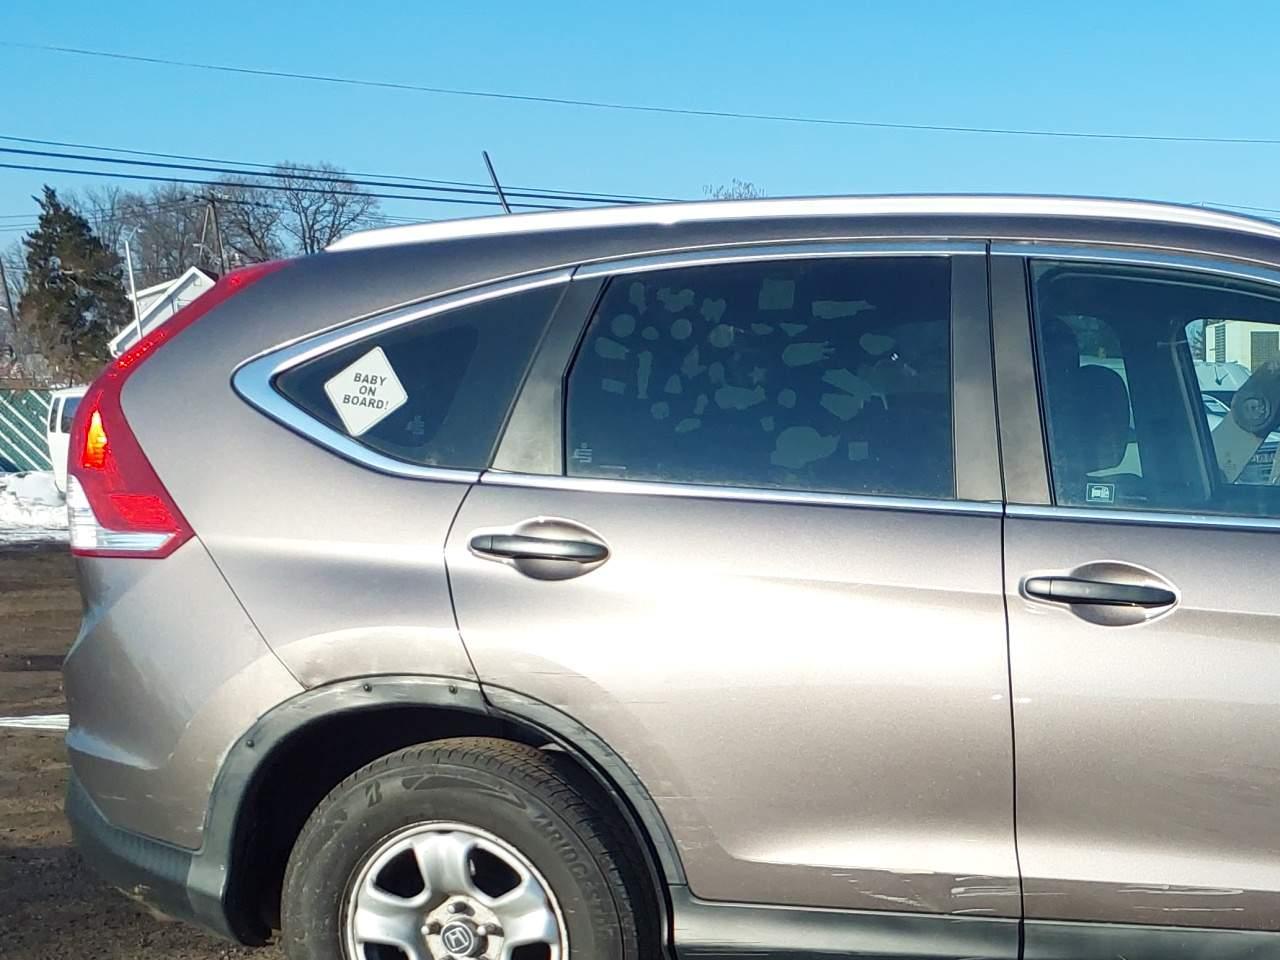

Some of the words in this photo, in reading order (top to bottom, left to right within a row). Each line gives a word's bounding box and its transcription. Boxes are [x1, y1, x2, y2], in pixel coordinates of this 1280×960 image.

[353, 372, 387, 386] BABY
[358, 385, 377, 397] ON
[342, 394, 389, 410] BOARD!
